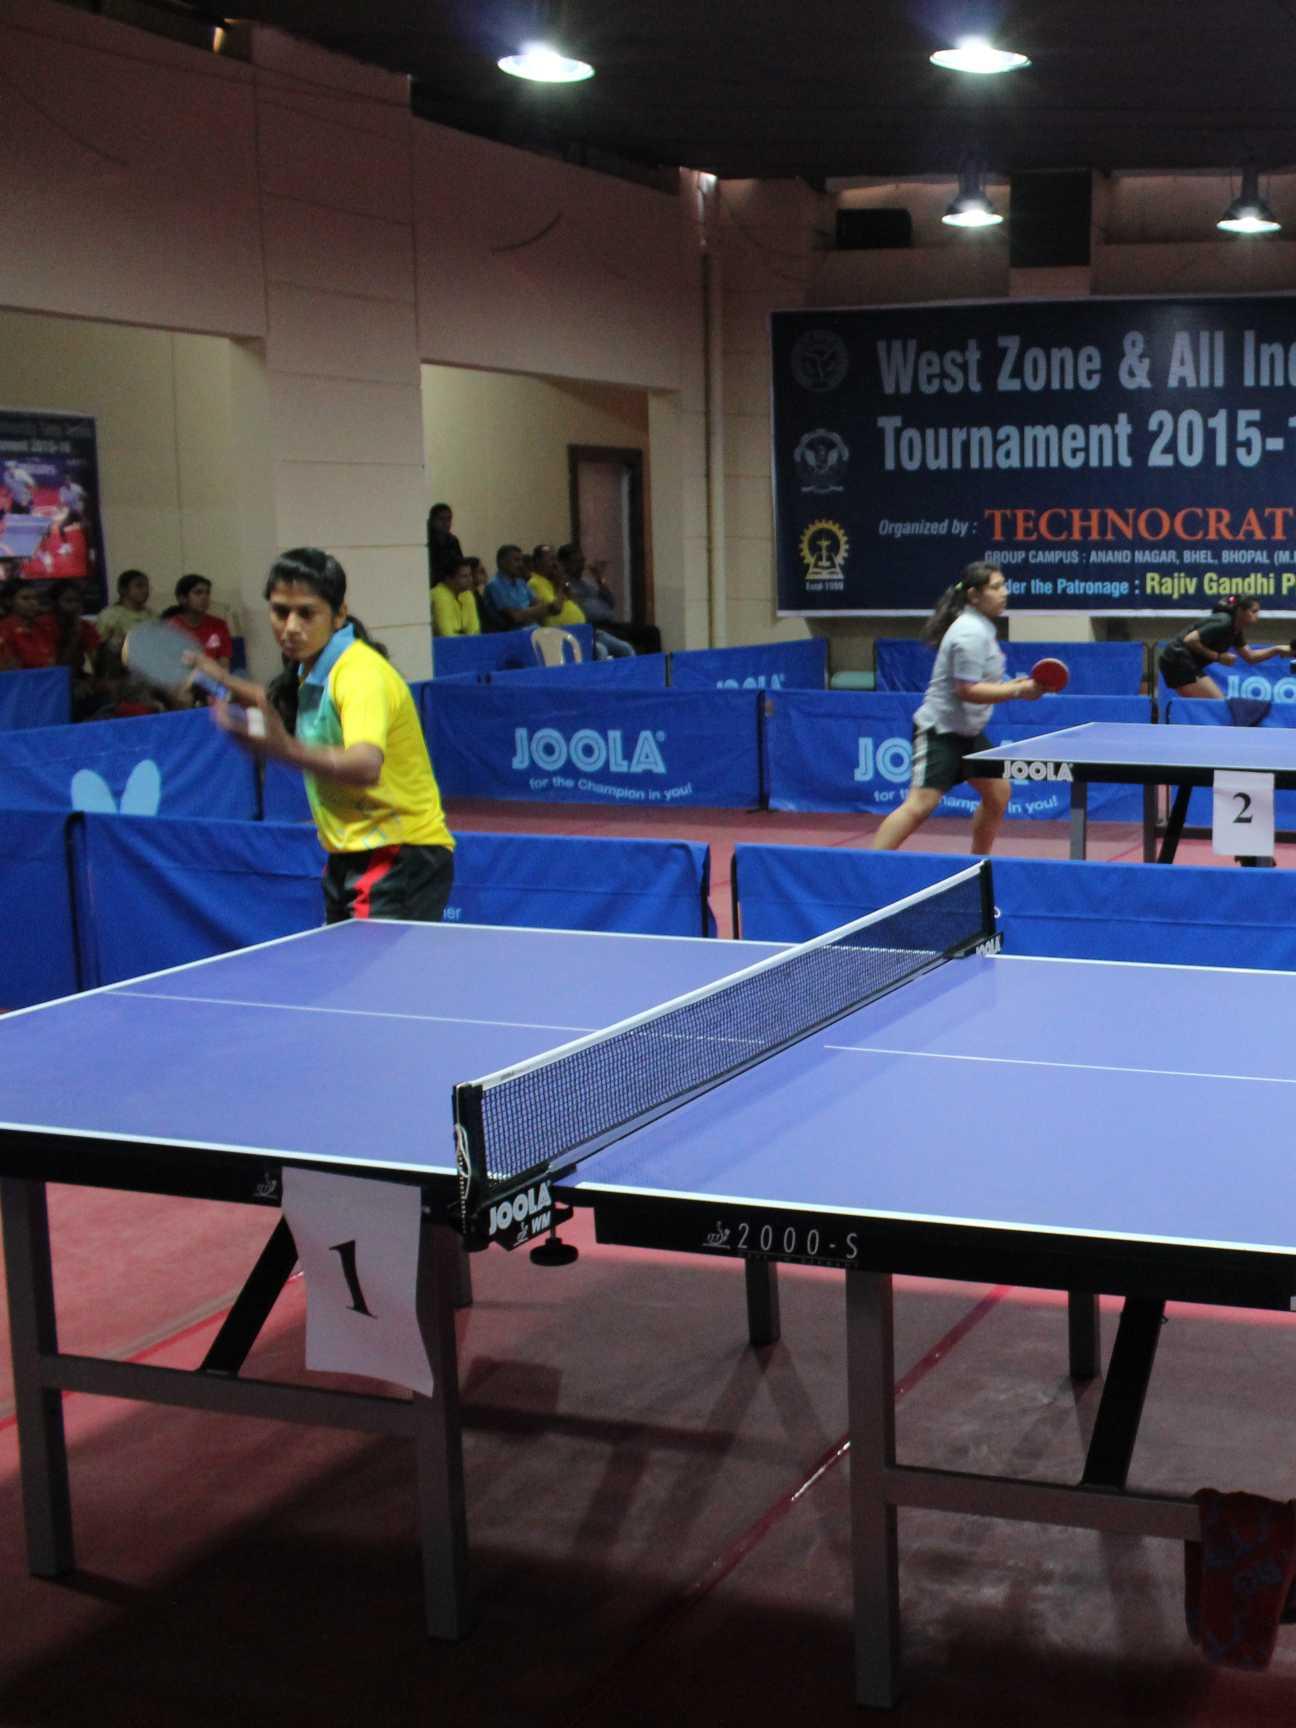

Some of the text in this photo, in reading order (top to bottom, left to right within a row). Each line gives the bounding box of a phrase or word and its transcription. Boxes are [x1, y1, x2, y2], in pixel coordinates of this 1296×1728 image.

[877, 338, 982, 394] West
[997, 335, 1101, 391] Zone
[1118, 331, 1151, 389] &
[1167, 330, 1225, 388] All
[877, 412, 1132, 471] Tournament
[878, 519, 949, 538] Organized
[951, 518, 969, 537] by
[1029, 550, 1078, 564] CAMPUS
[1090, 550, 1131, 564] ANAND
[1134, 550, 1179, 565] NAGAR,
[1183, 550, 1218, 565] BHEL,
[1222, 550, 1270, 564] BHOPAL
[1003, 579, 1026, 594] der
[1031, 579, 1052, 594] the
[1057, 578, 1129, 597] Patronage
[1146, 573, 1197, 599] Rajiv
[1203, 572, 1275, 595] Gandhi
[529, 777, 547, 790] for
[552, 776, 574, 788] the
[578, 778, 645, 799] Champion
[649, 789, 661, 799] in
[1232, 792, 1254, 823] 2
[737, 1222, 858, 1260] 2000-S
[329, 1239, 379, 1320] 1
